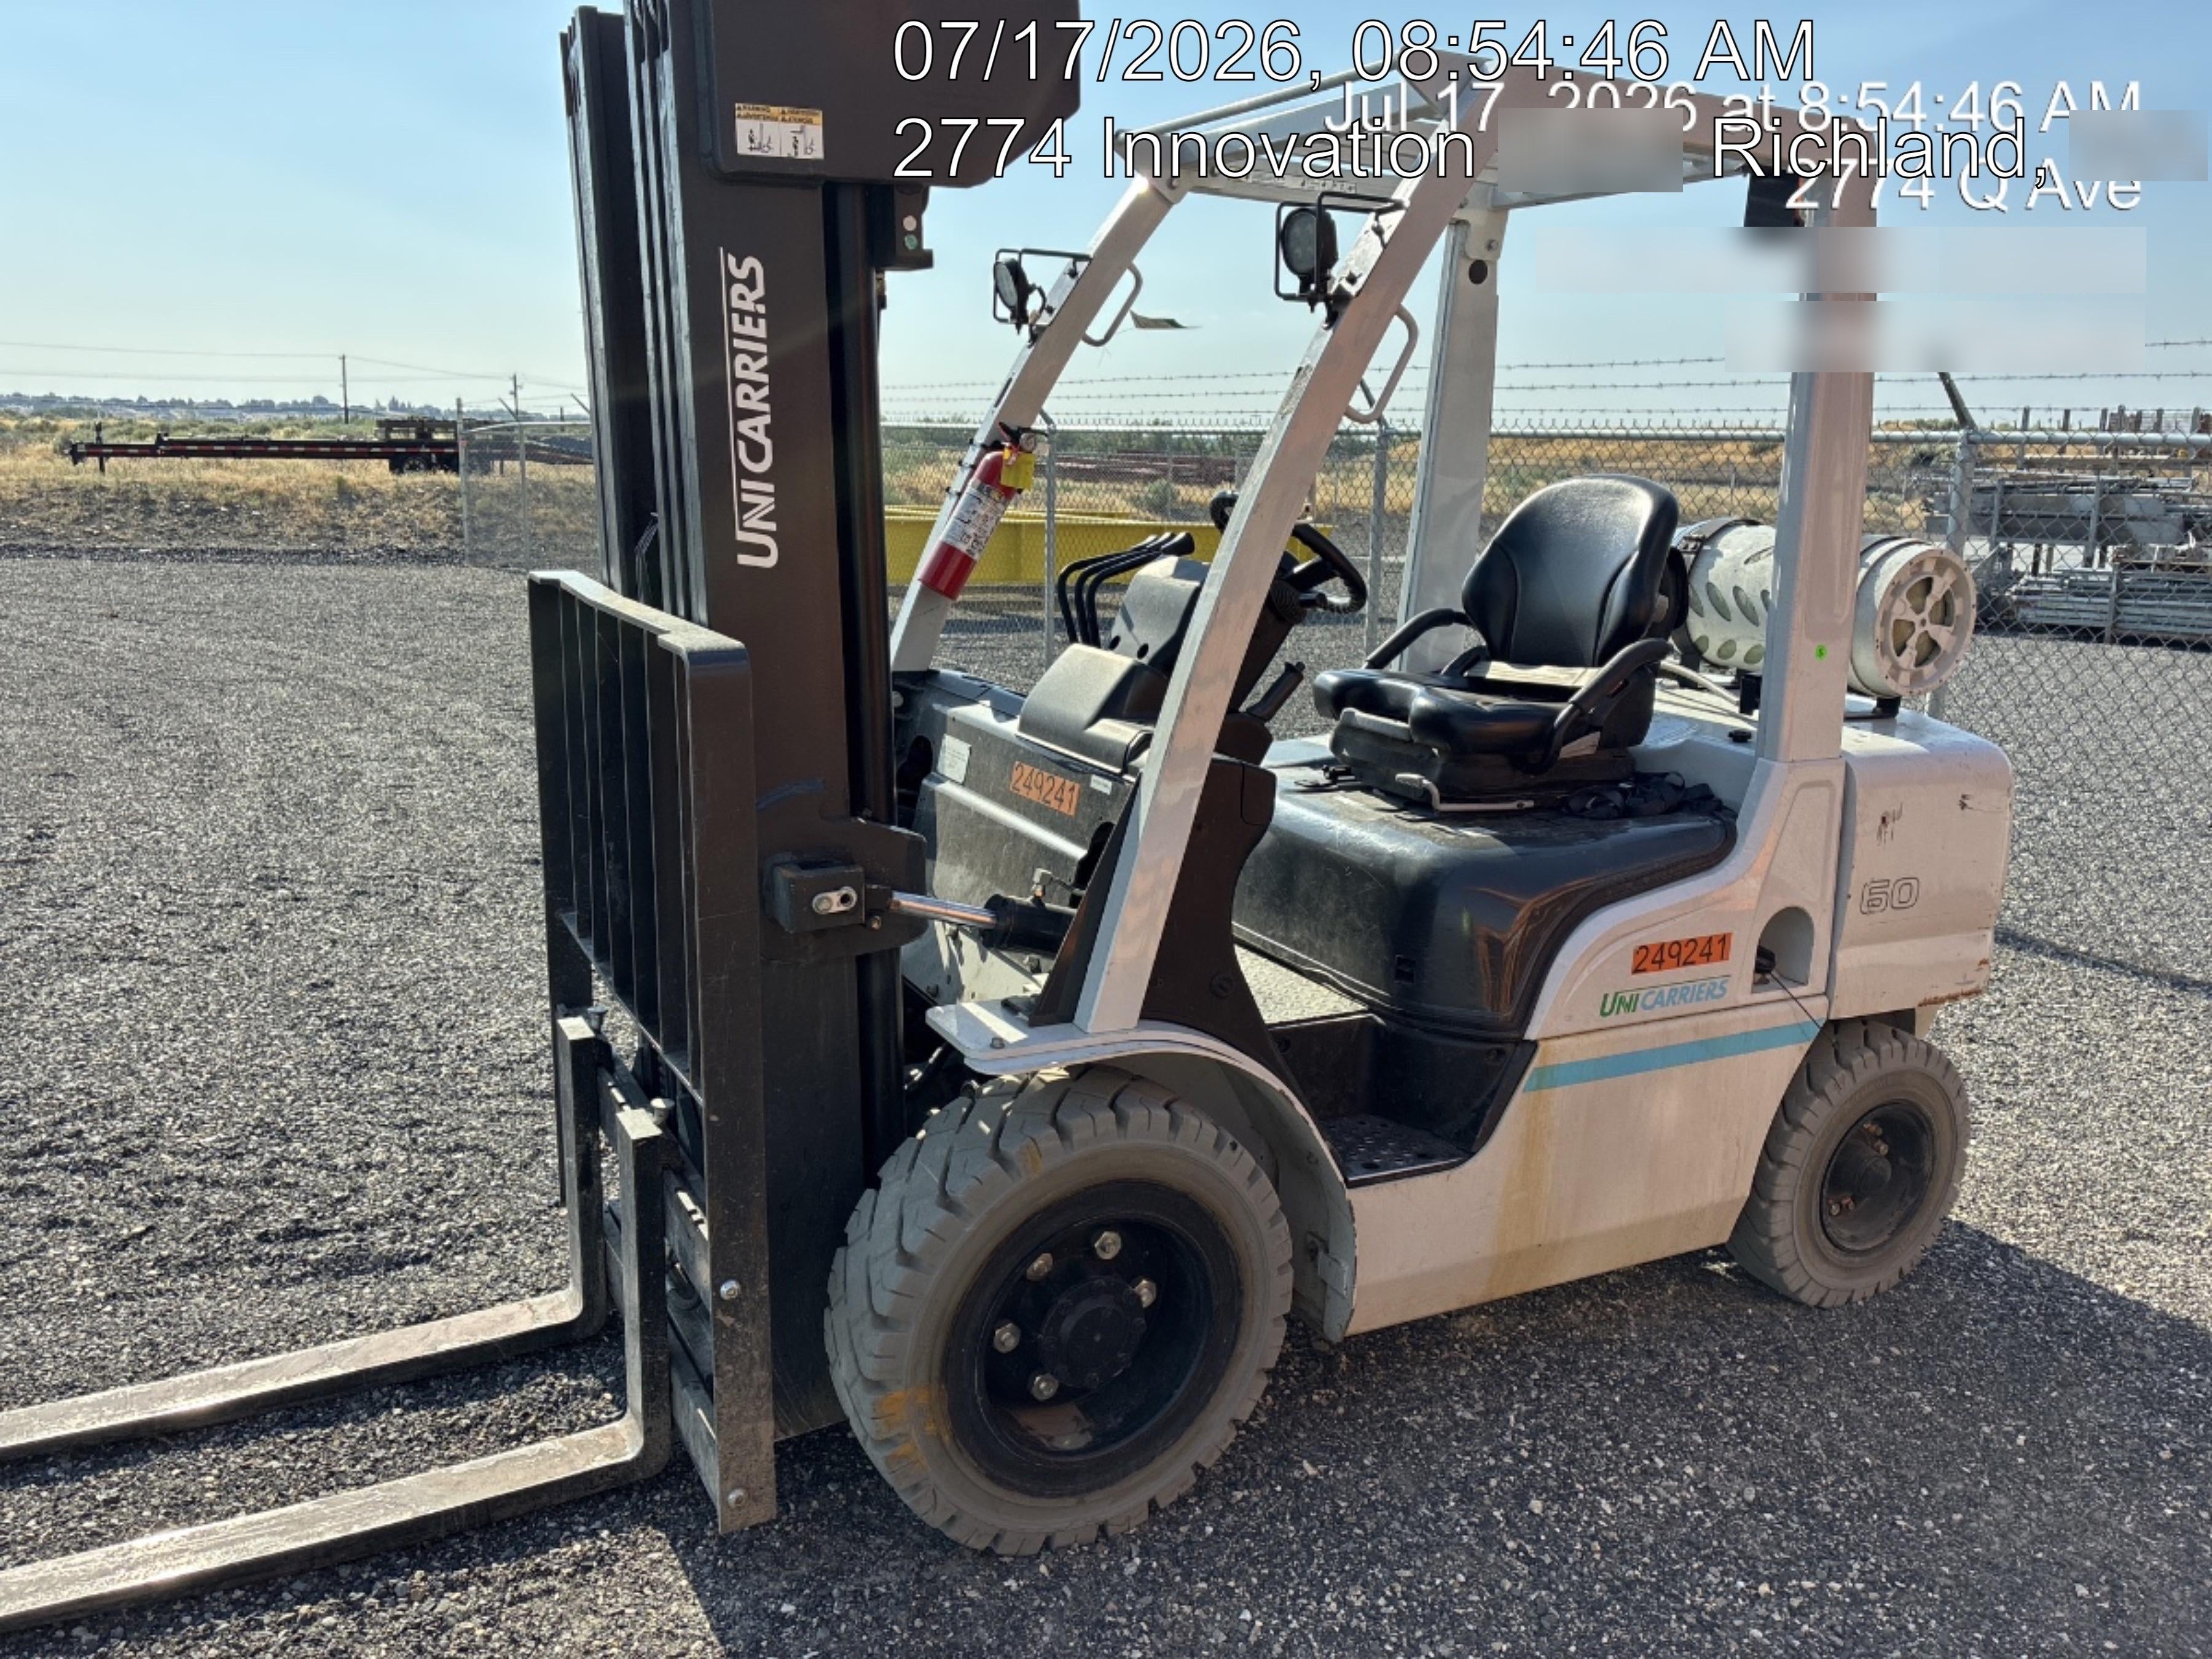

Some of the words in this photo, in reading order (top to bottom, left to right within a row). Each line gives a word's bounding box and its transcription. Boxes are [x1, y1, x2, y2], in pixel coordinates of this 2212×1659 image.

[1011, 763, 1077, 814] 249241
[1859, 876, 1920, 915] 60
[1632, 933, 1727, 975] 249241
